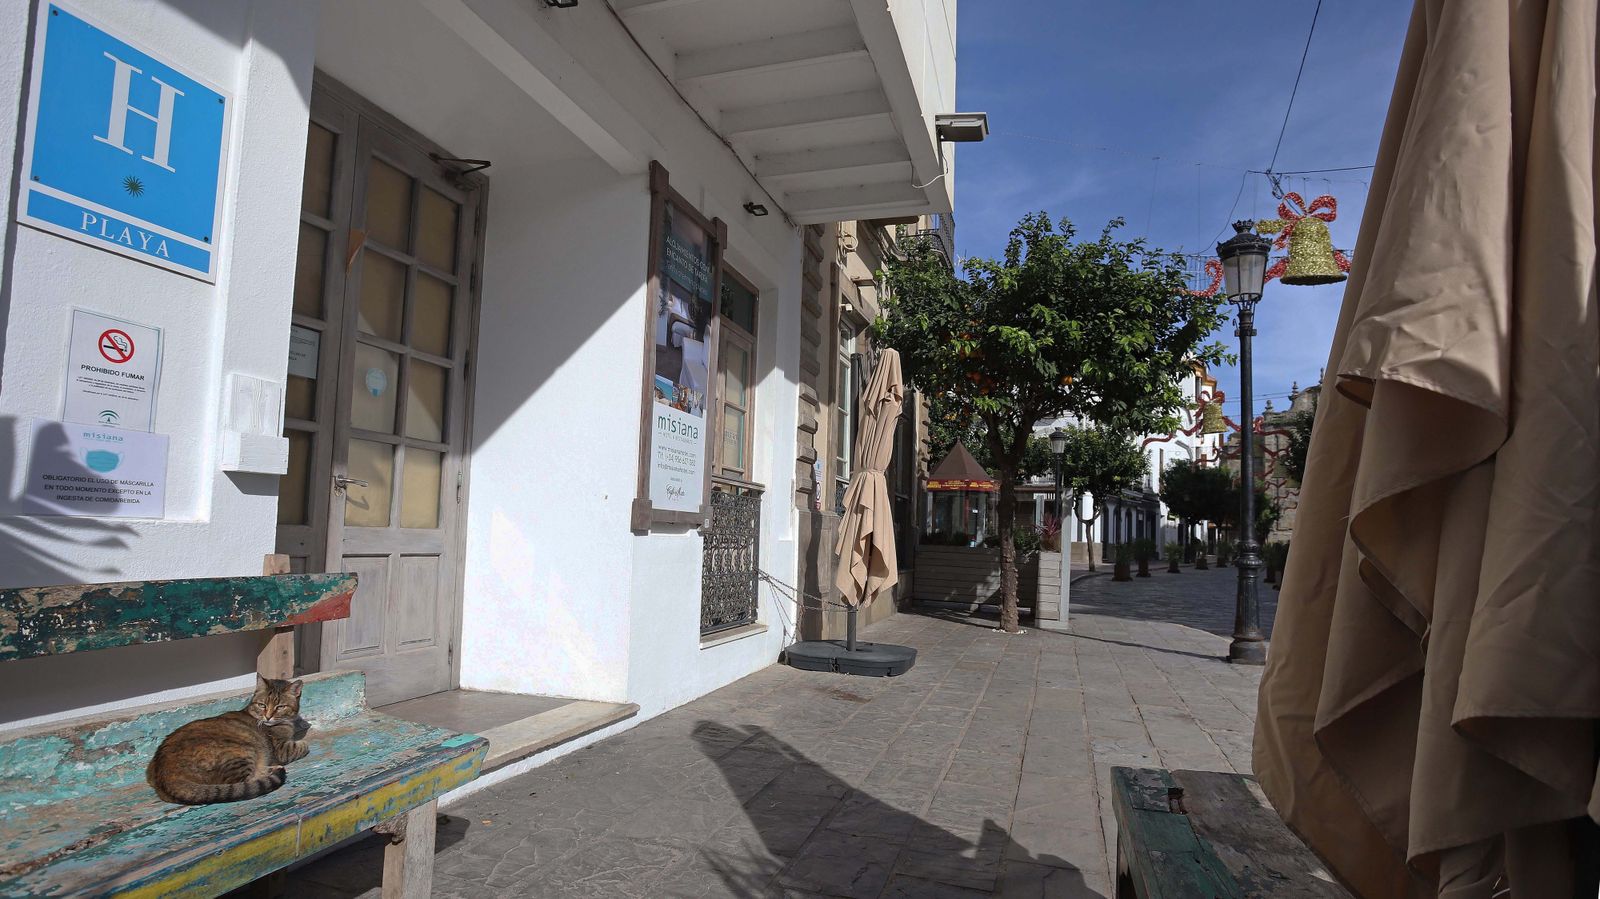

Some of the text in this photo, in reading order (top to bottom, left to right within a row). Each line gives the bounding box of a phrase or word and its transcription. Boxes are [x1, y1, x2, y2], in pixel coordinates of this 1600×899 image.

[93, 51, 185, 173] H
[81, 211, 171, 259] PLAYA
[81, 364, 145, 381] PROHIBIDO FUMAR
[83, 432, 124, 442] misiana
[657, 413, 698, 440] misiana
[42, 474, 87, 483] OBLIGATORIO
